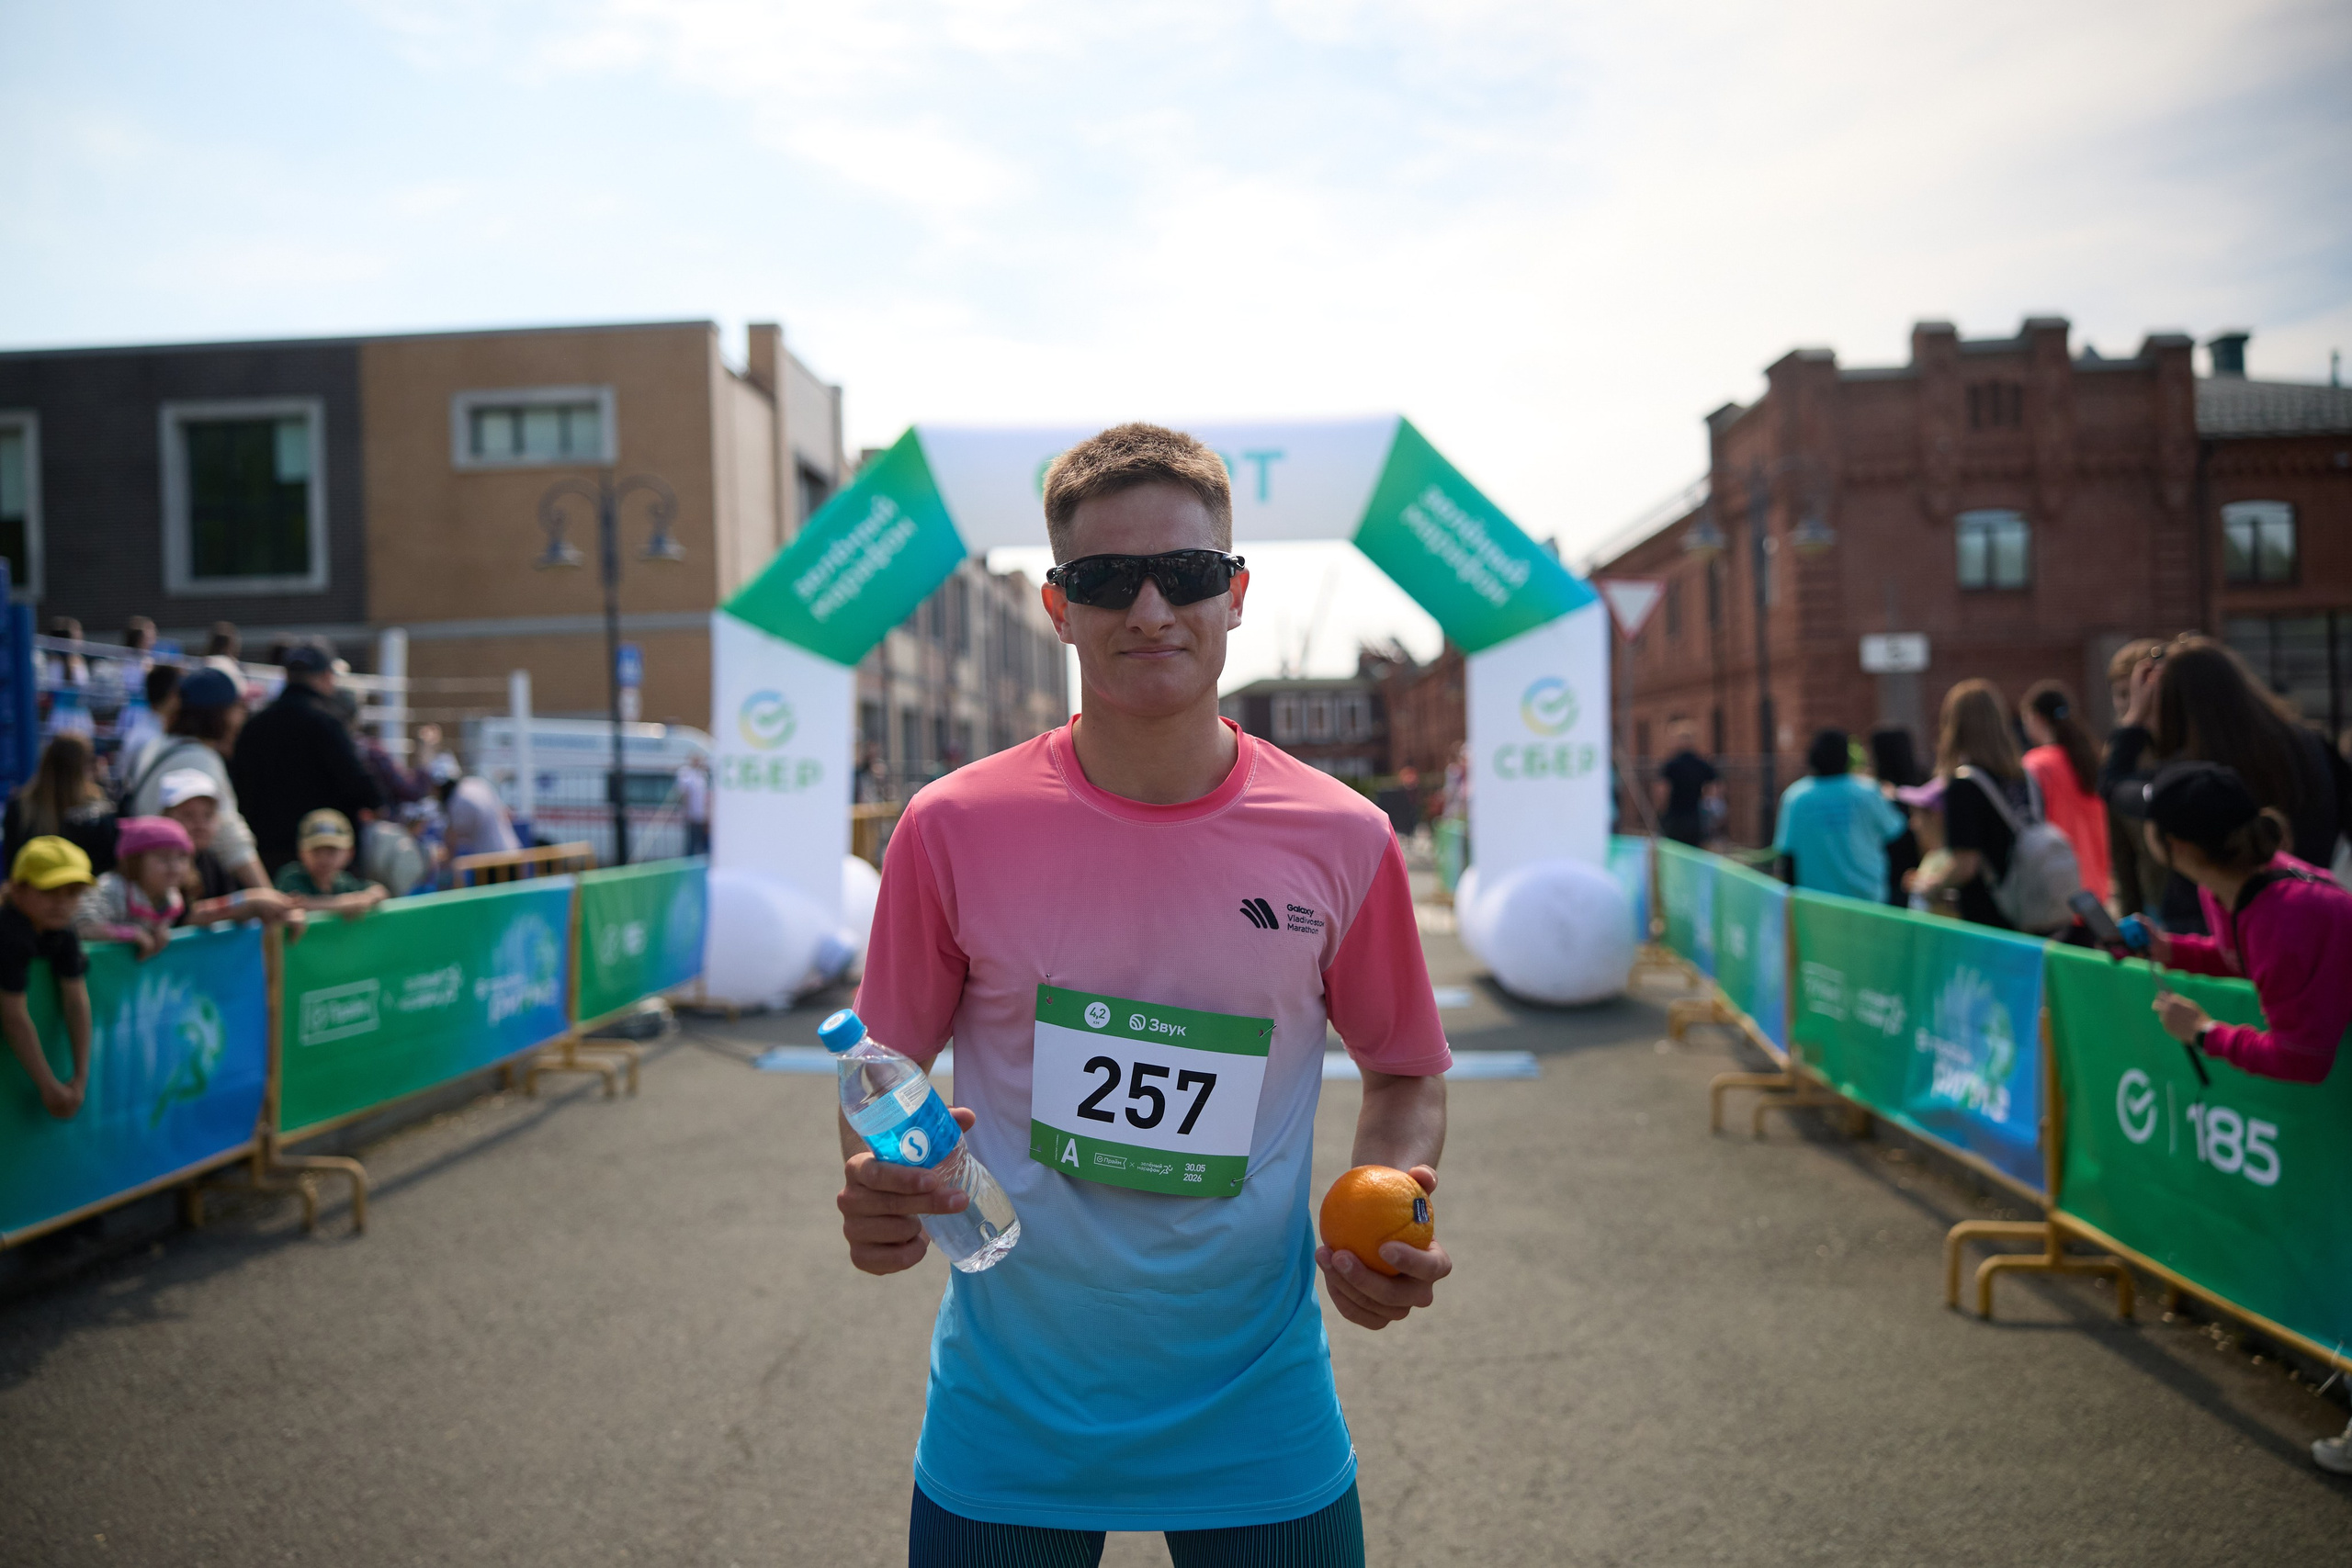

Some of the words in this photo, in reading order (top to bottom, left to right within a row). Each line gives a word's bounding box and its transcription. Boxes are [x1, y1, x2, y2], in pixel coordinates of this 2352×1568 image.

[1492, 740, 1600, 781] СБЕР
[1286, 904, 1314, 918] Galaxy
[1287, 923, 1318, 935] Marathon
[1089, 1007, 1106, 1020] 4,2
[1148, 1018, 1187, 1037] Звук
[1077, 1055, 1217, 1135] 257
[2186, 1103, 2281, 1187] 185
[1184, 1163, 1206, 1173] 30.05
[1182, 1173, 1203, 1183] 2026
